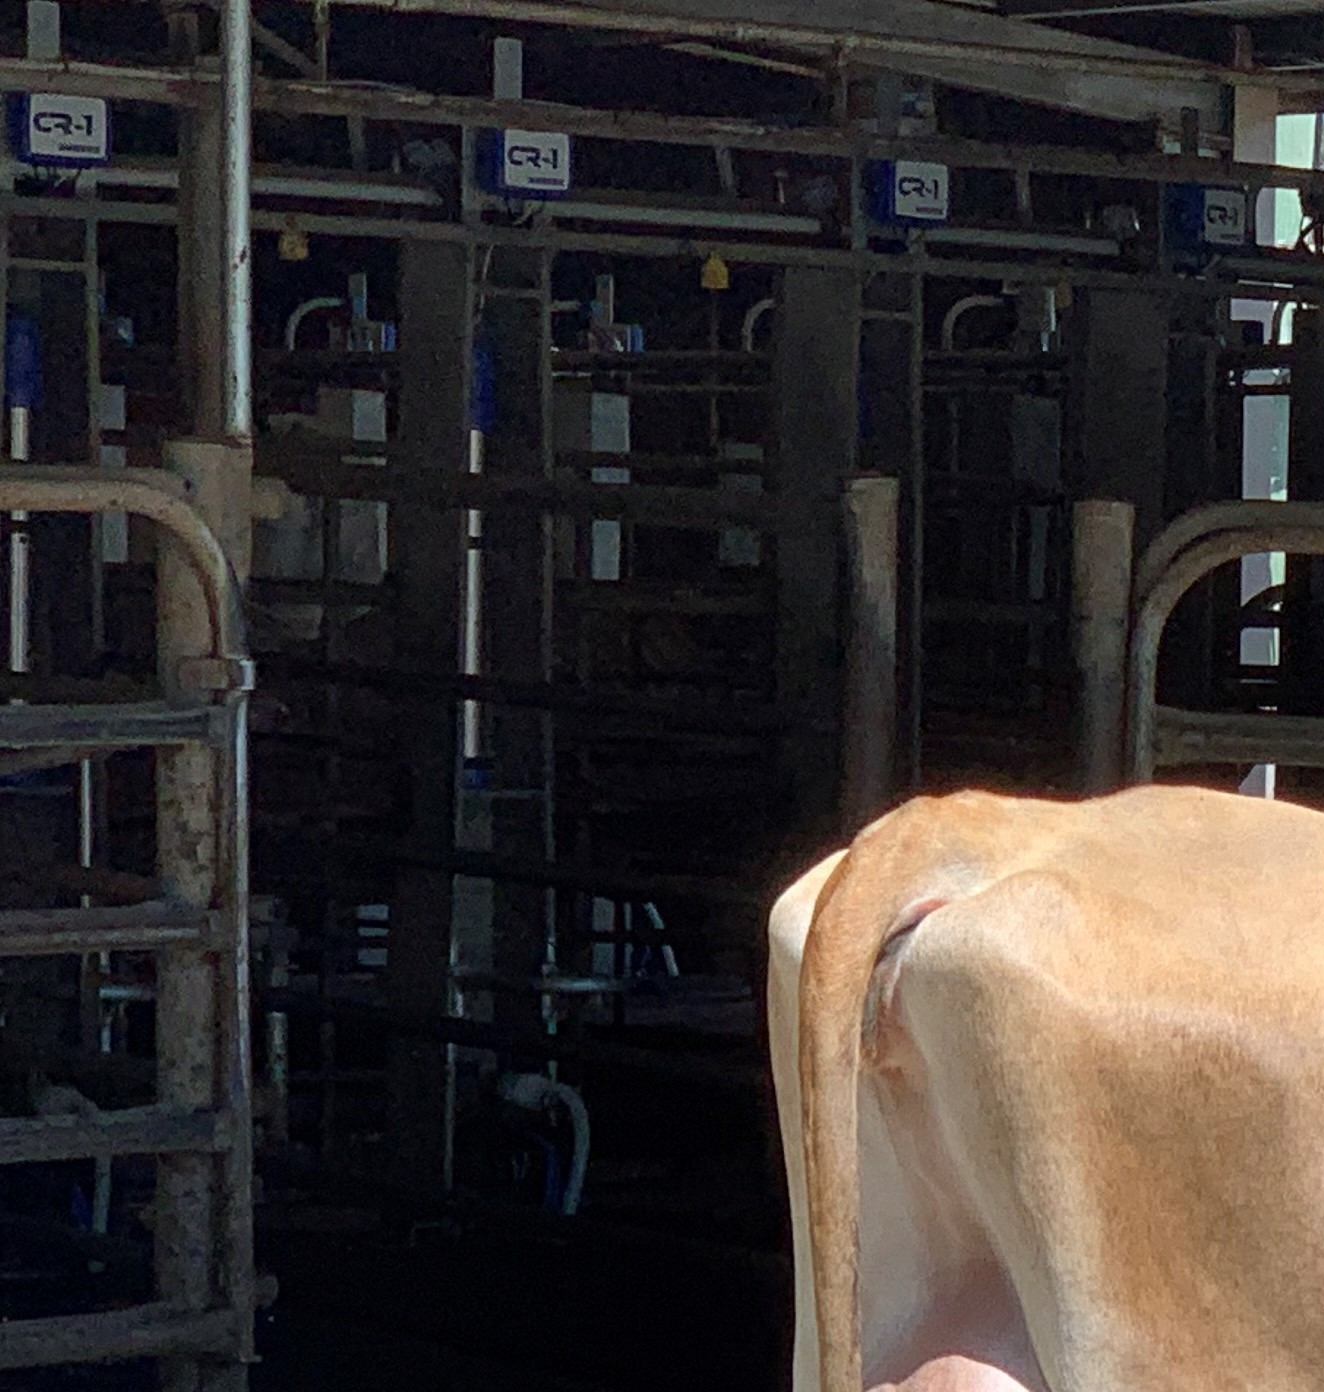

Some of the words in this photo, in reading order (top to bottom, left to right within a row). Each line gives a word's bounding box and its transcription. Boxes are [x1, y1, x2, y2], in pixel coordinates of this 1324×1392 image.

[33, 111, 93, 136] CR-1
[507, 145, 558, 169] CR-1
[898, 176, 938, 200] CR-1
